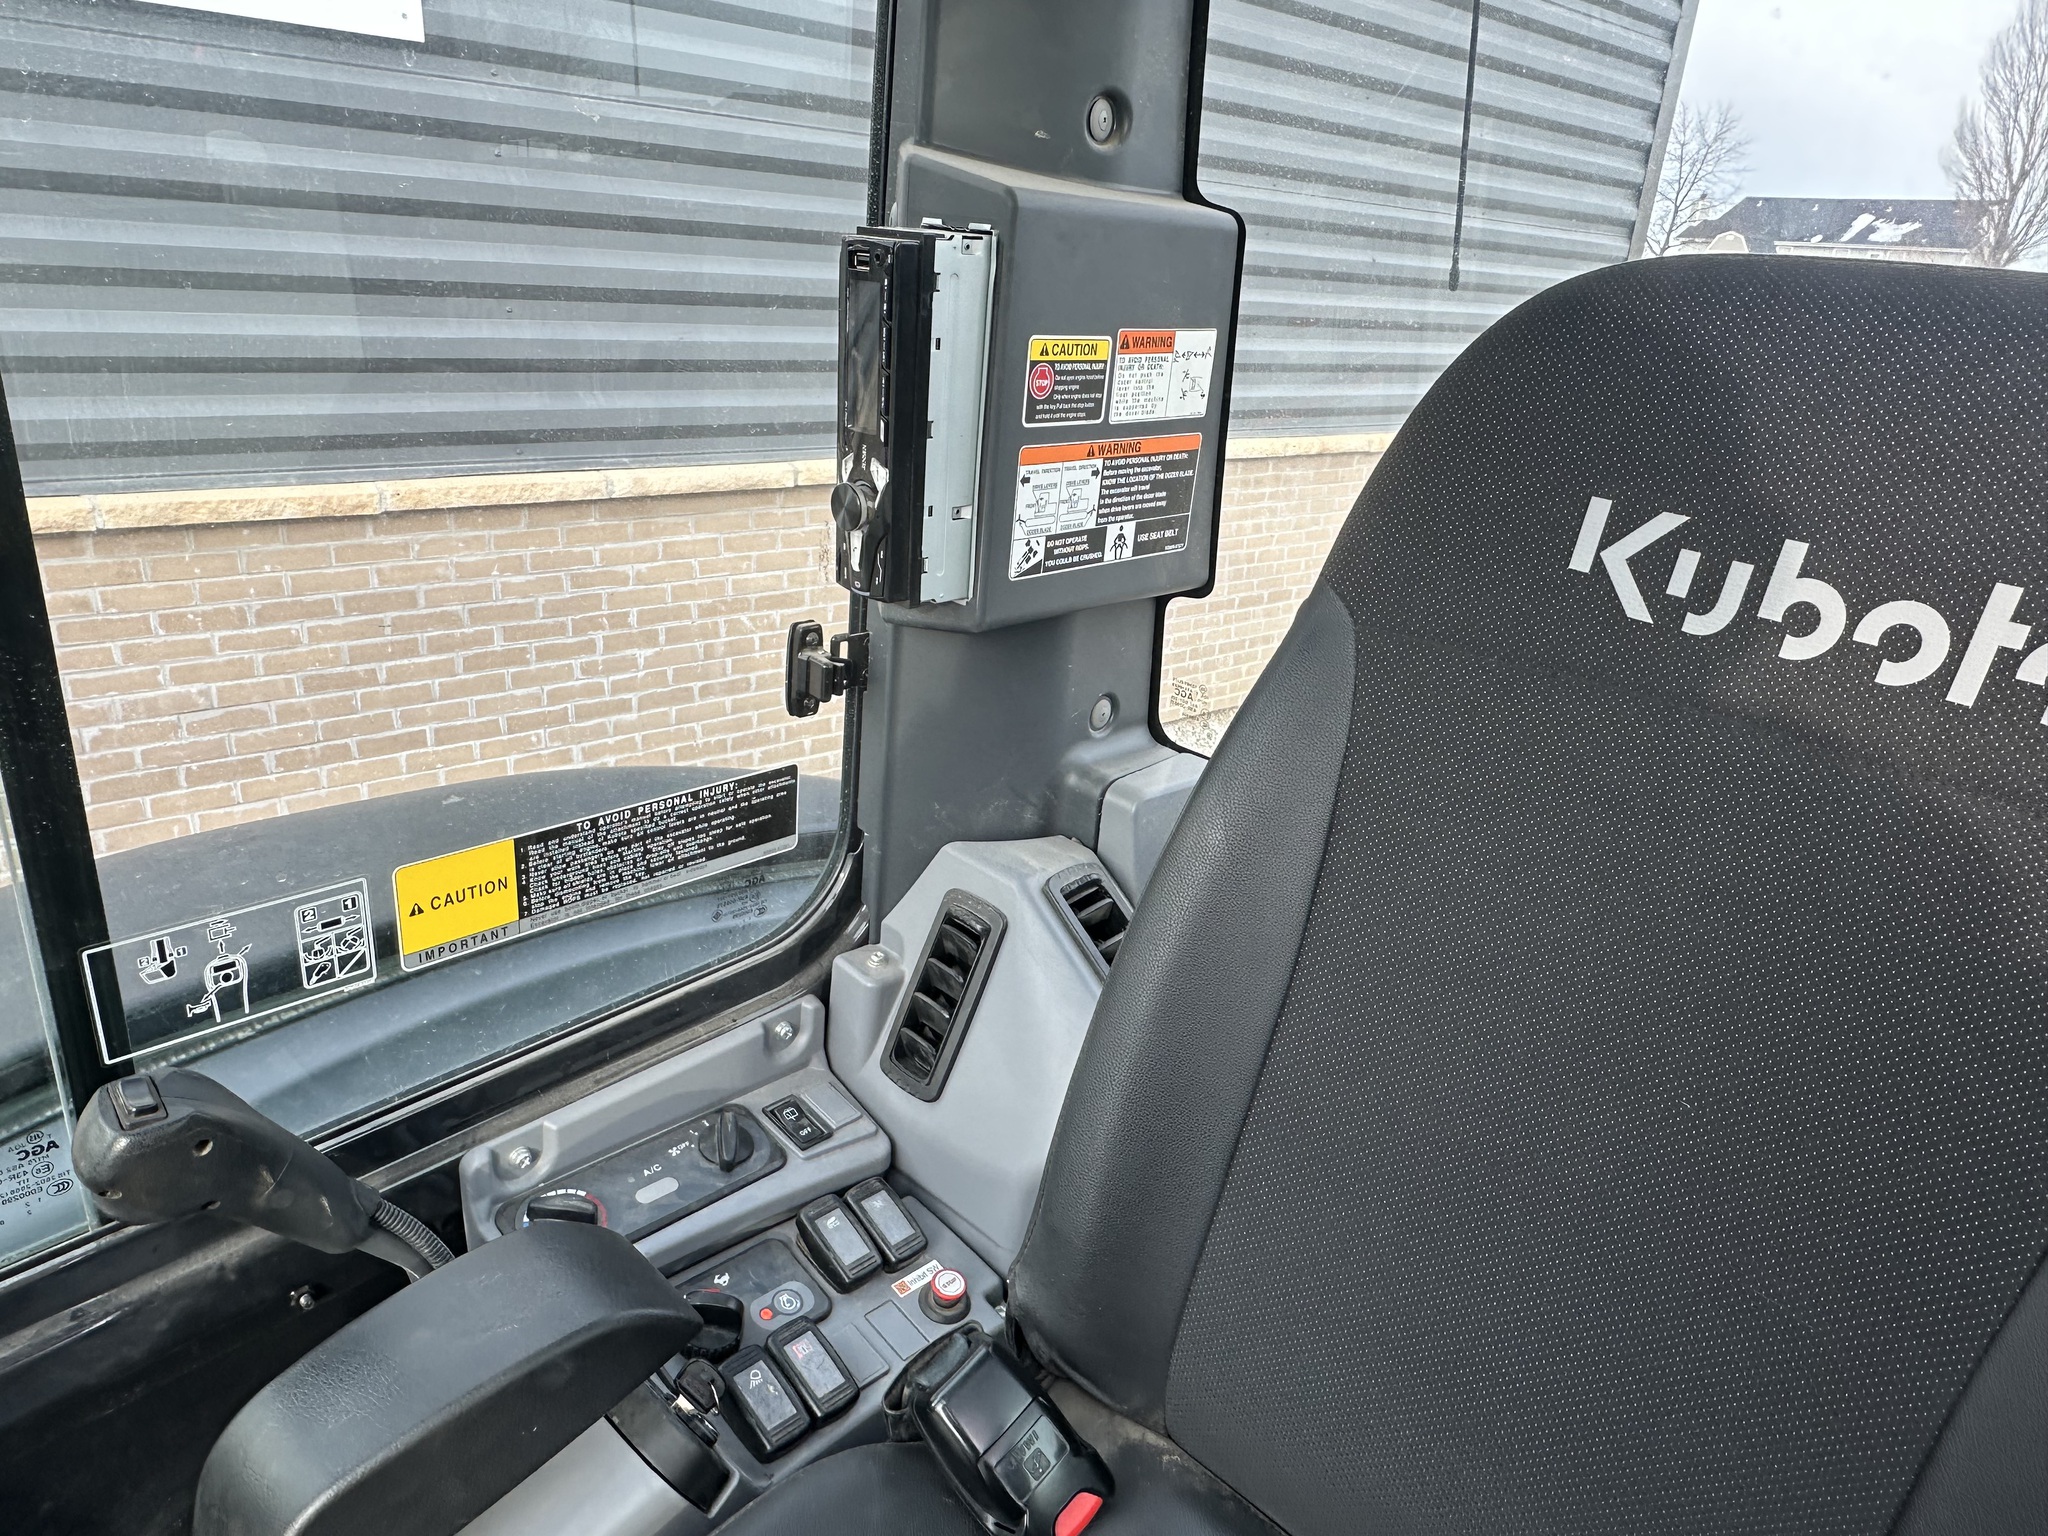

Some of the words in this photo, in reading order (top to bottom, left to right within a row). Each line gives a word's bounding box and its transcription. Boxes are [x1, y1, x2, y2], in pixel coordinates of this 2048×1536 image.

[1132, 336, 1172, 348] WARNING
[1052, 343, 1098, 356] CAUTION
[1036, 379, 1048, 387] STOP
[1098, 441, 1142, 456] WARNING
[1054, 538, 1064, 546] NOT
[1065, 534, 1087, 544] OPERATE
[1137, 532, 1149, 541] USE
[1149, 530, 1164, 540] SEAT
[1164, 528, 1178, 537] BELT
[1044, 559, 1055, 567] YOU
[1055, 556, 1072, 565] COULD
[576, 820, 590, 832] TO
[597, 809, 631, 826] AVOID
[638, 793, 693, 815] PERSONAL
[699, 780, 738, 798] INJURY:
[430, 877, 508, 910] CAUTION
[304, 909, 315, 920] 2
[345, 899, 355, 910] 1
[419, 927, 508, 963] IMPORTANT
[799, 1127, 813, 1136] OFF
[643, 1163, 662, 1177] A/C
[907, 1271, 929, 1287] Inhibit
